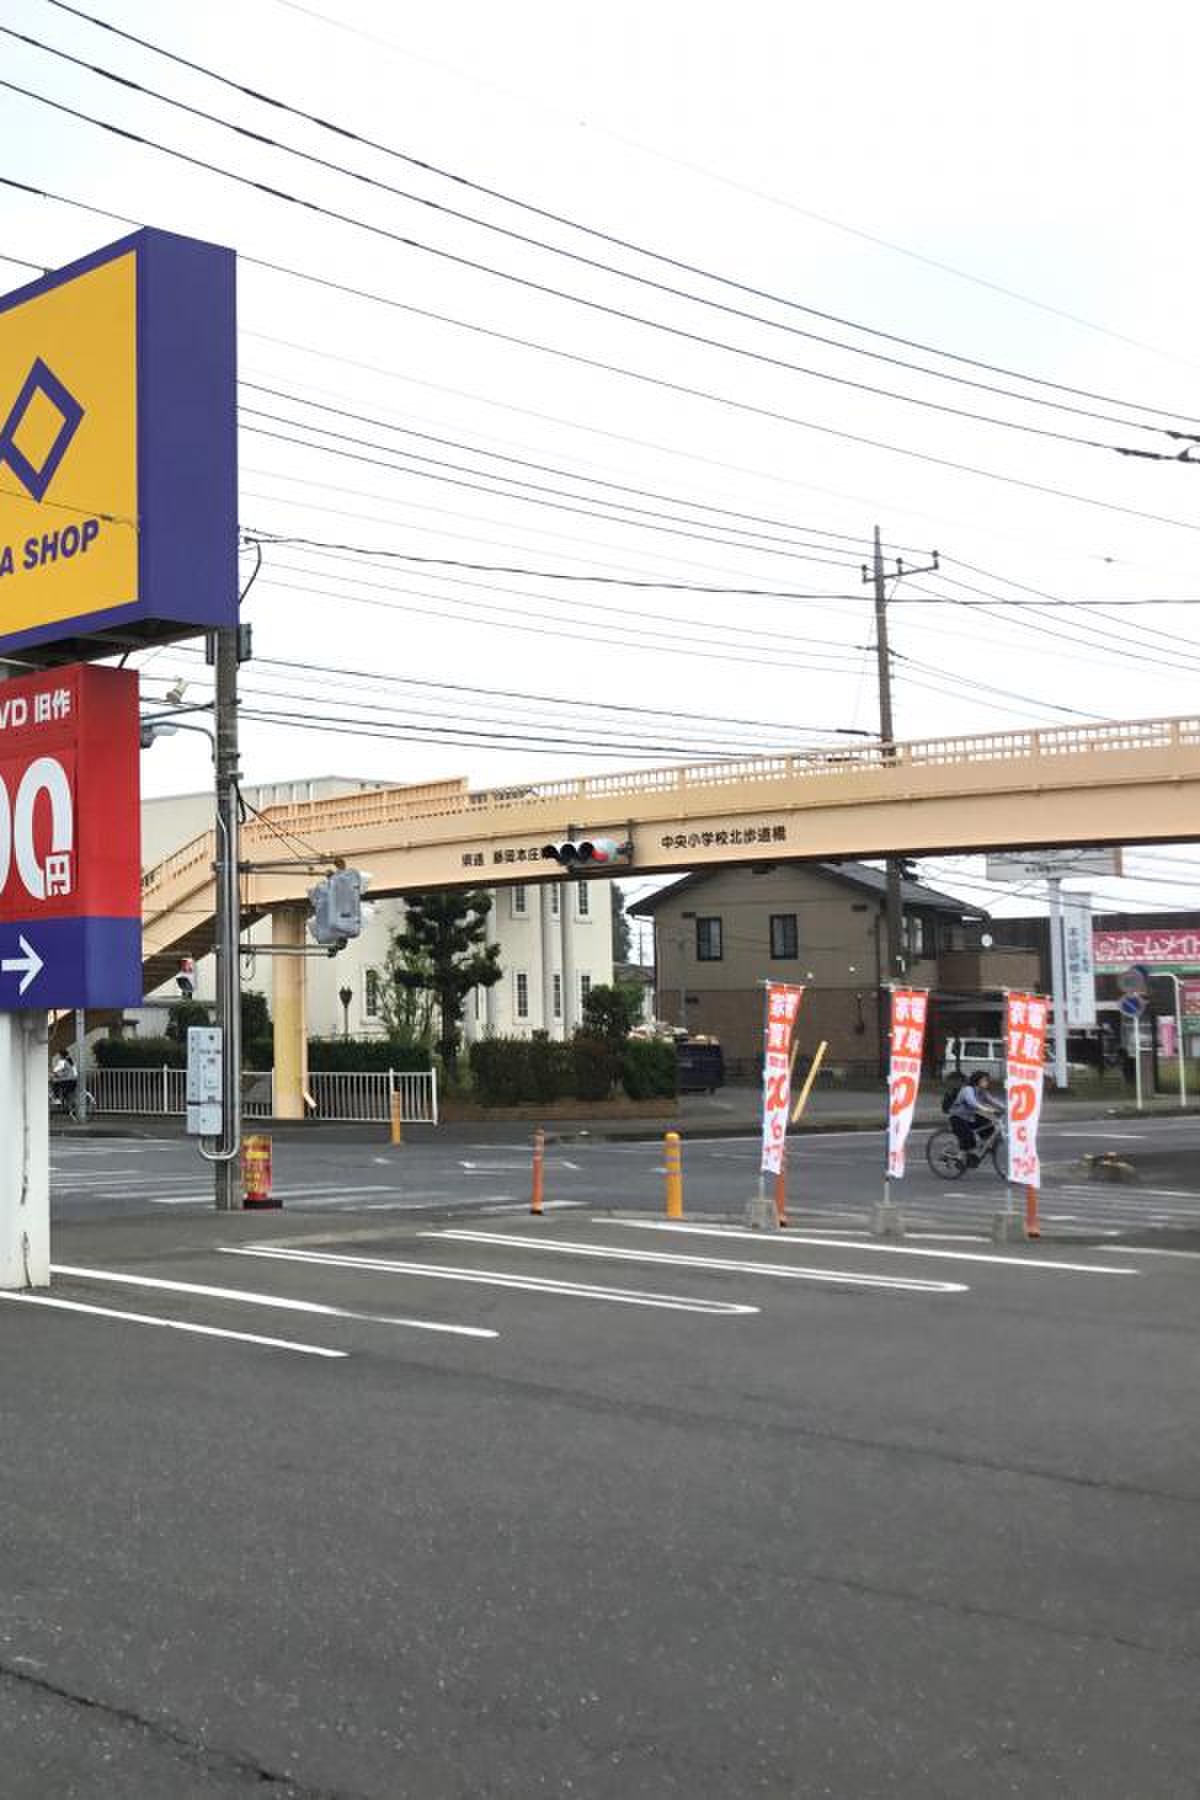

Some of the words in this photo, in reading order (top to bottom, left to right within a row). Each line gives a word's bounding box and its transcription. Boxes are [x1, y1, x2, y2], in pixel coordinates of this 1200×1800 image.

[23, 519, 100, 570] SHOP
[34, 689, 72, 723] 旧作
[660, 824, 788, 850] 中央小学校北歩道橋
[493, 846, 547, 865] 藤岡本庄
